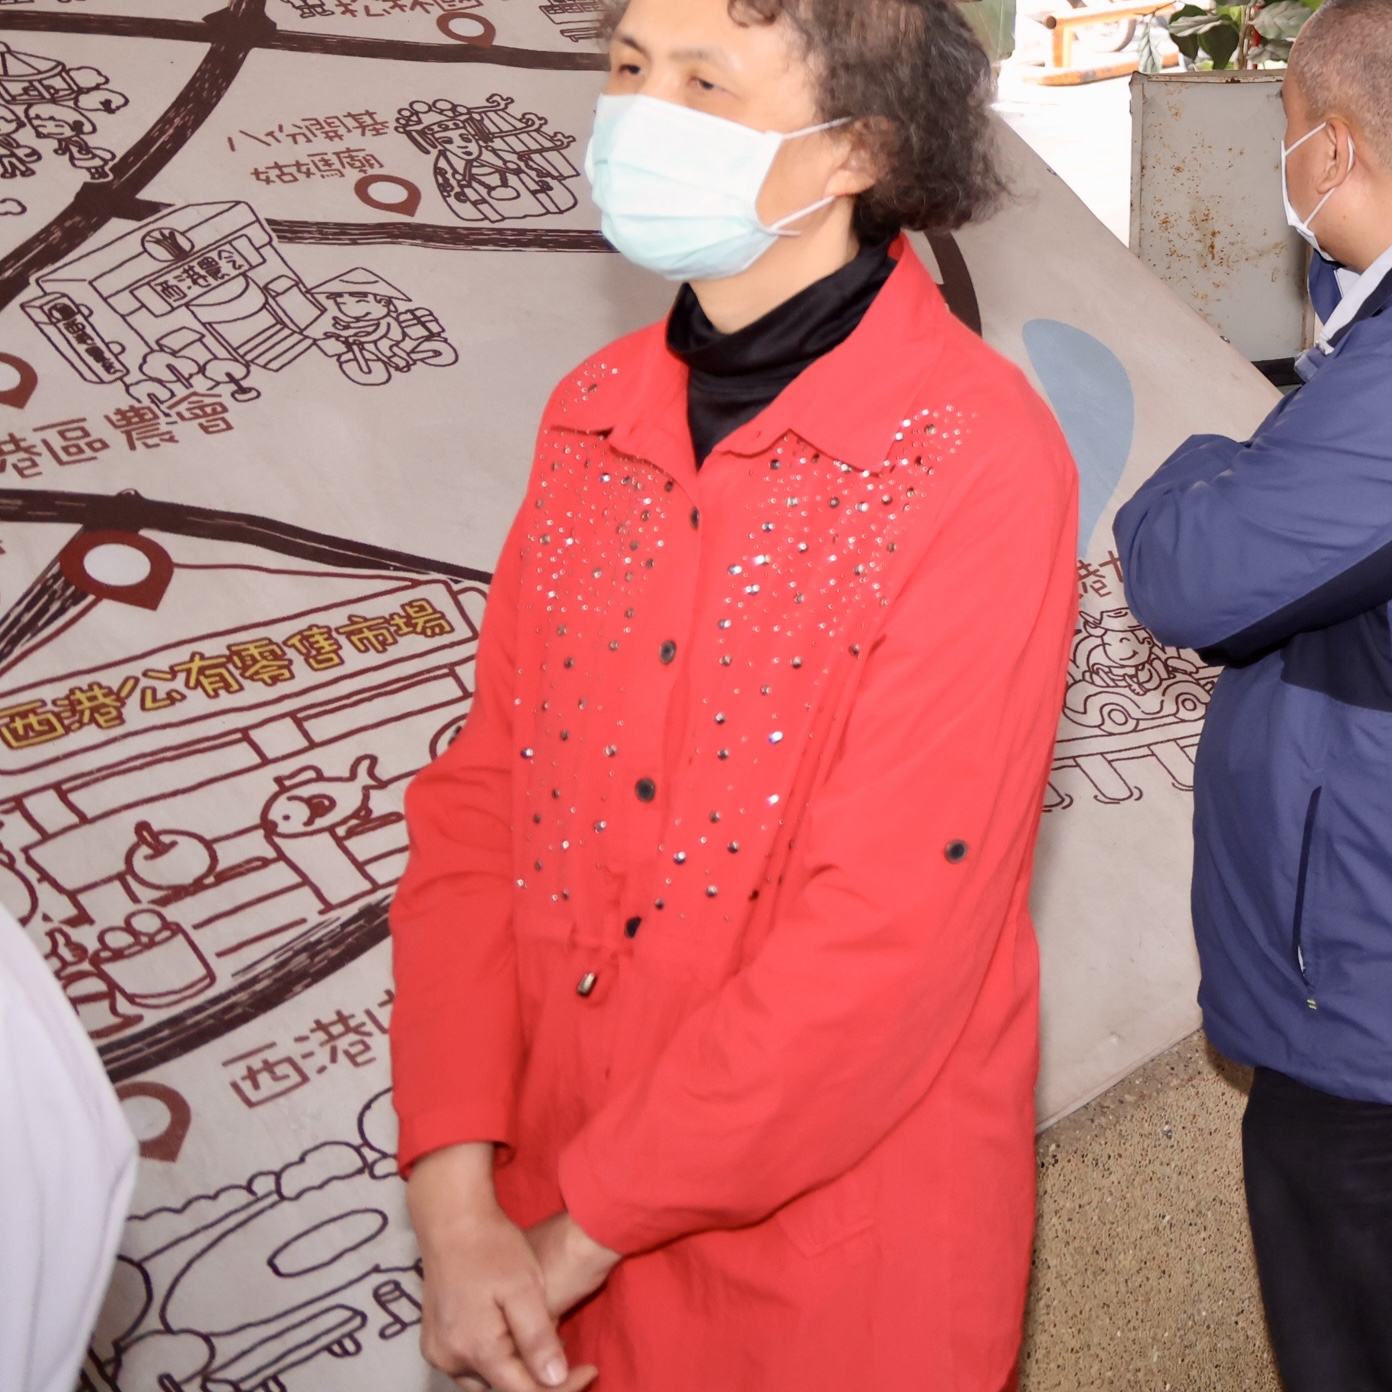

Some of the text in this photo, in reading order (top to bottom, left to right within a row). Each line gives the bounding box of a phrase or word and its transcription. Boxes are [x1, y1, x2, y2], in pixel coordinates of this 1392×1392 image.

[227, 110, 390, 152] 八份開基
[250, 147, 384, 185] 姑媽廟
[0, 599, 455, 750] 西港公有零售市場
[222, 989, 395, 1108] 西港
